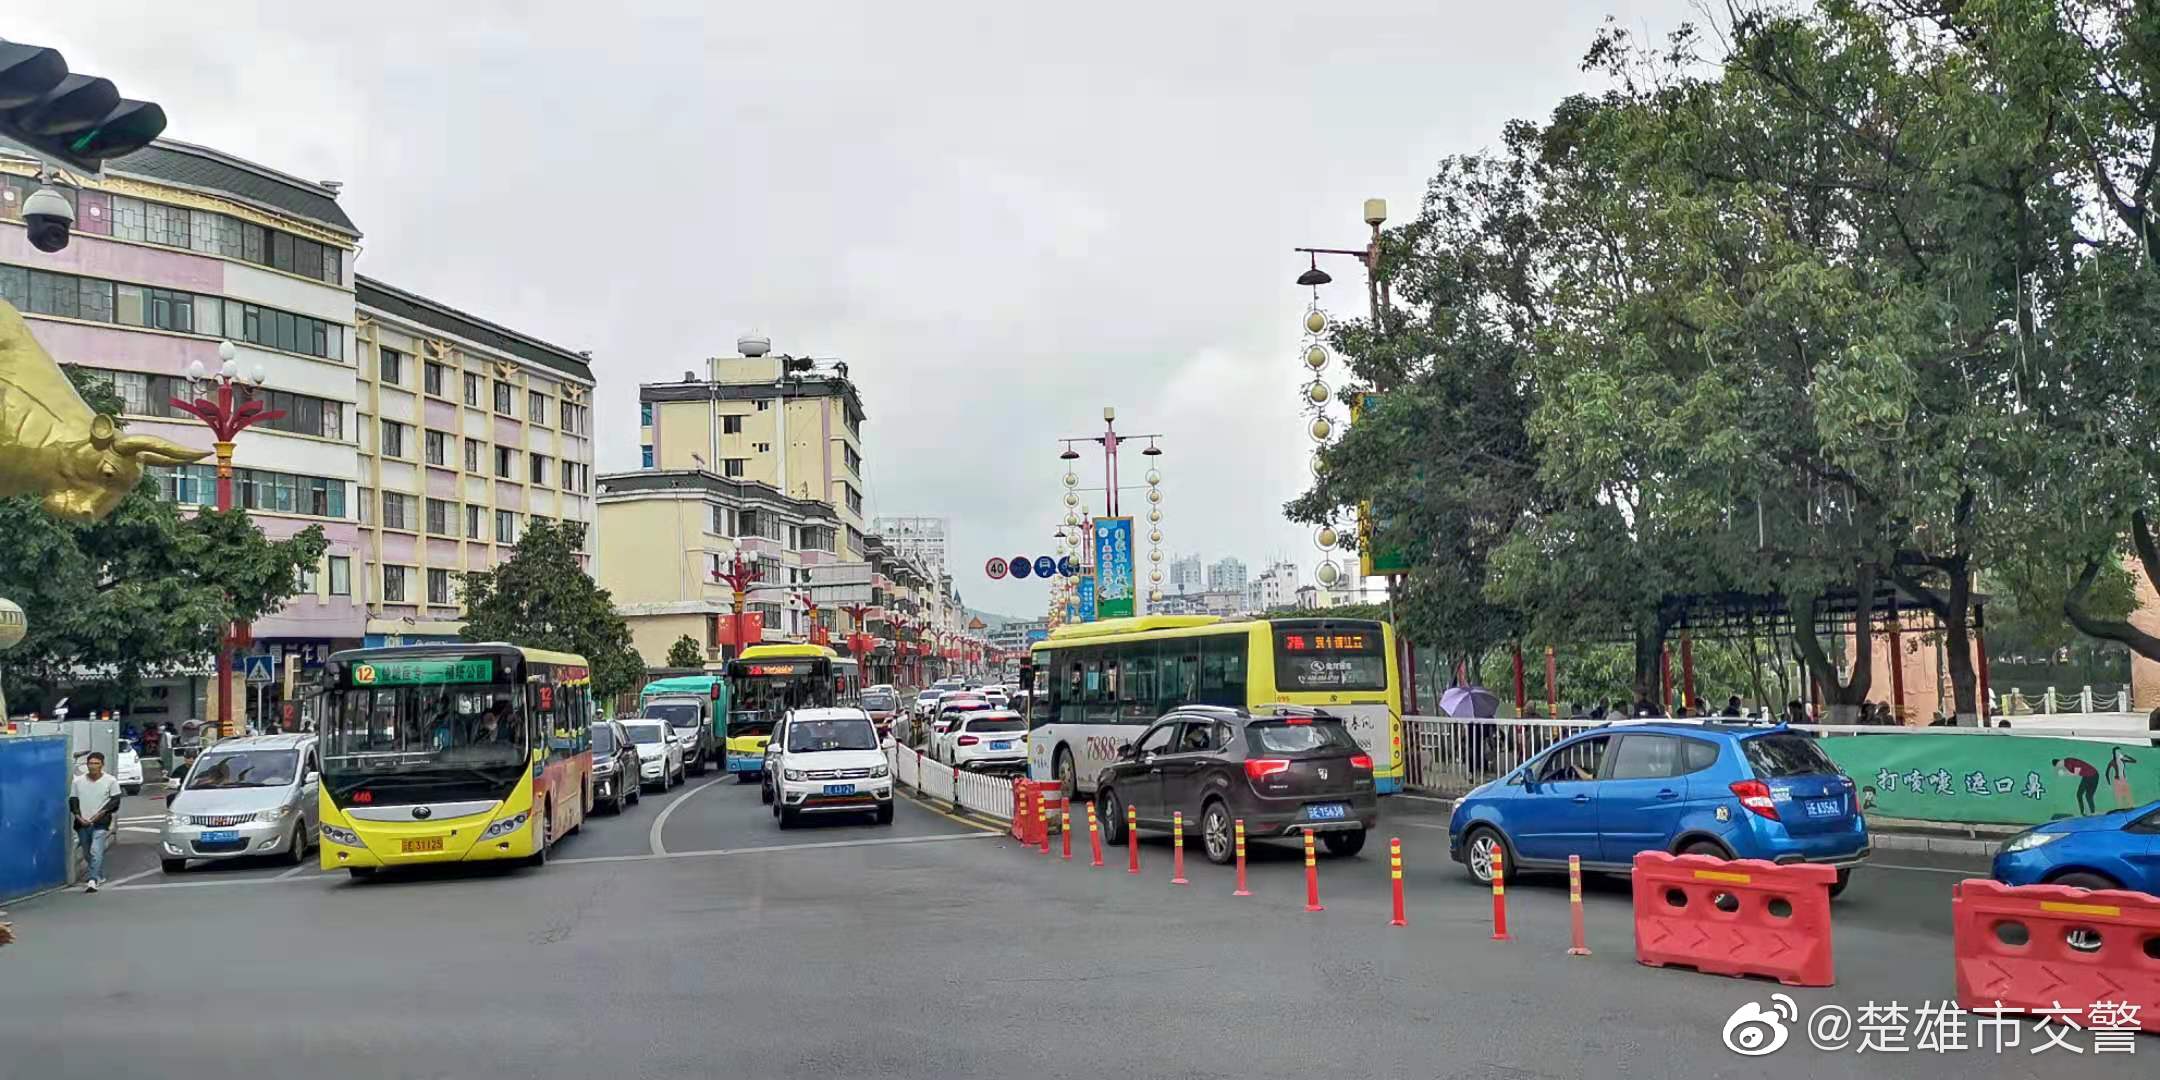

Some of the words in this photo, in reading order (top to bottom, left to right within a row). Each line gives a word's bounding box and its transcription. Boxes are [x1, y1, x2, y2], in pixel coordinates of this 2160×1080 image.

[990, 563, 1004, 574] 40
[357, 667, 373, 680] 12
[539, 687, 552, 701] 12
[1876, 767, 1955, 796] 打喷嚏
[1964, 770, 2046, 800] 遮口鼻
